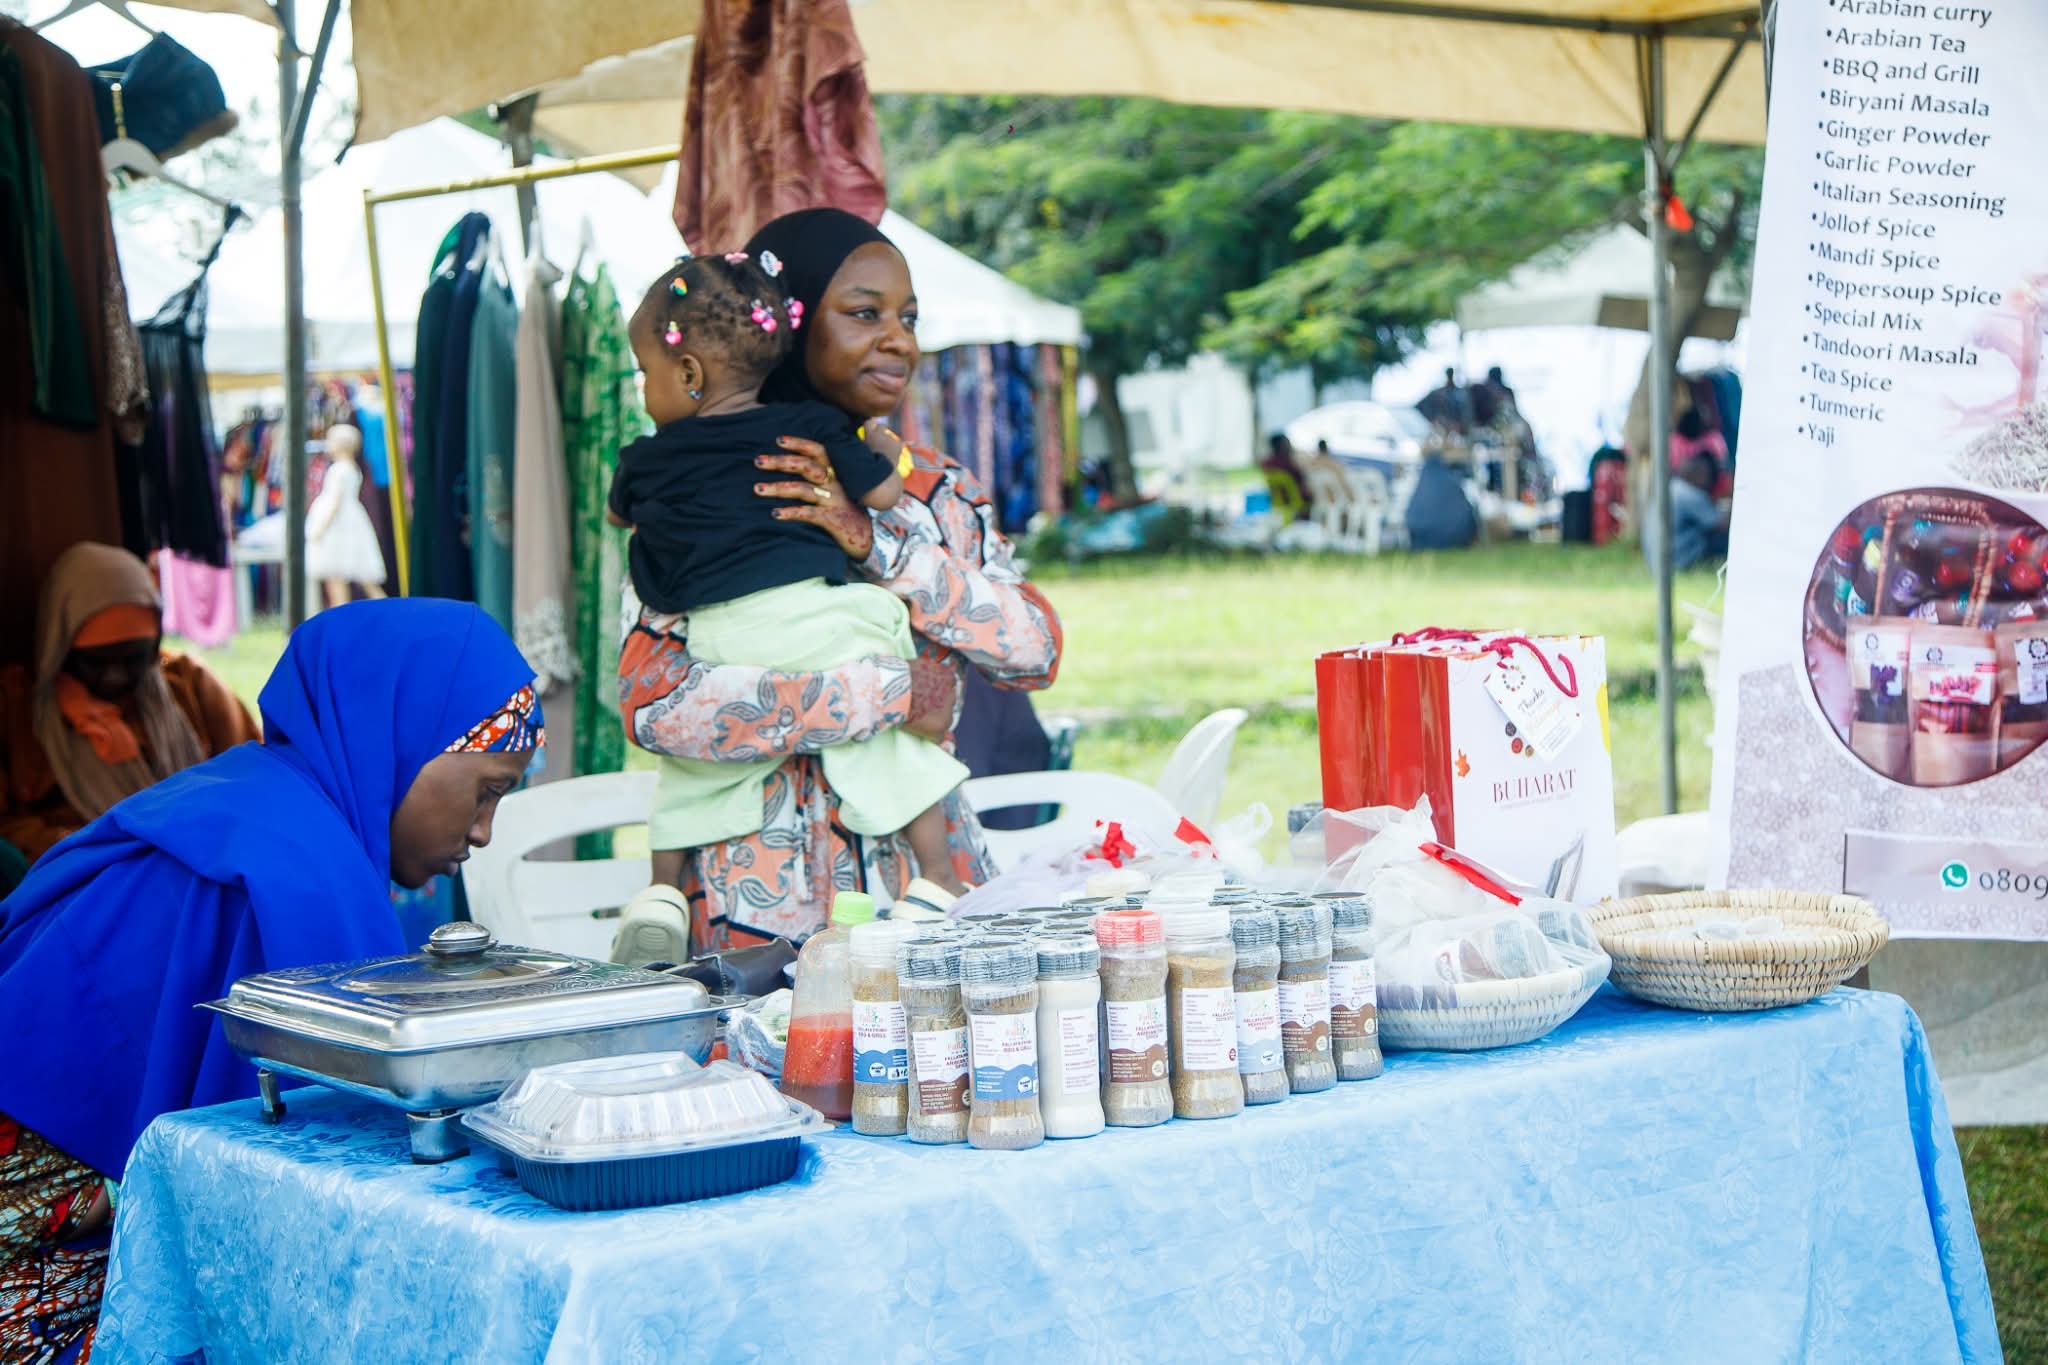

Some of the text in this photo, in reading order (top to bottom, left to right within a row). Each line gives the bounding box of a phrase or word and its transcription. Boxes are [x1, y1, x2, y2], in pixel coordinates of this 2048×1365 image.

[1839, 0, 1993, 29] Arabian curry
[1835, 27, 1966, 53] Arabian Tea
[1832, 57, 1980, 85] BBQ and Grill
[1829, 88, 1990, 117] Biryani Masala
[1826, 120, 1991, 148] Ginger Powder
[1824, 150, 1976, 178] Garlic Powder
[1822, 180, 2006, 217] Italian Seasoning
[1819, 211, 1936, 241] Jollof Spice
[1818, 241, 1940, 272] Mandi Spice
[1816, 271, 2001, 308] Peppersoup Spice
[1814, 302, 1924, 331] Special Mix
[1812, 331, 1979, 366] Tandoori Masala
[1810, 362, 1893, 393] Tea Spice
[1809, 393, 1885, 422] Turmeric
[1808, 422, 1835, 448] Yaji
[1979, 868, 2048, 901] 0809
